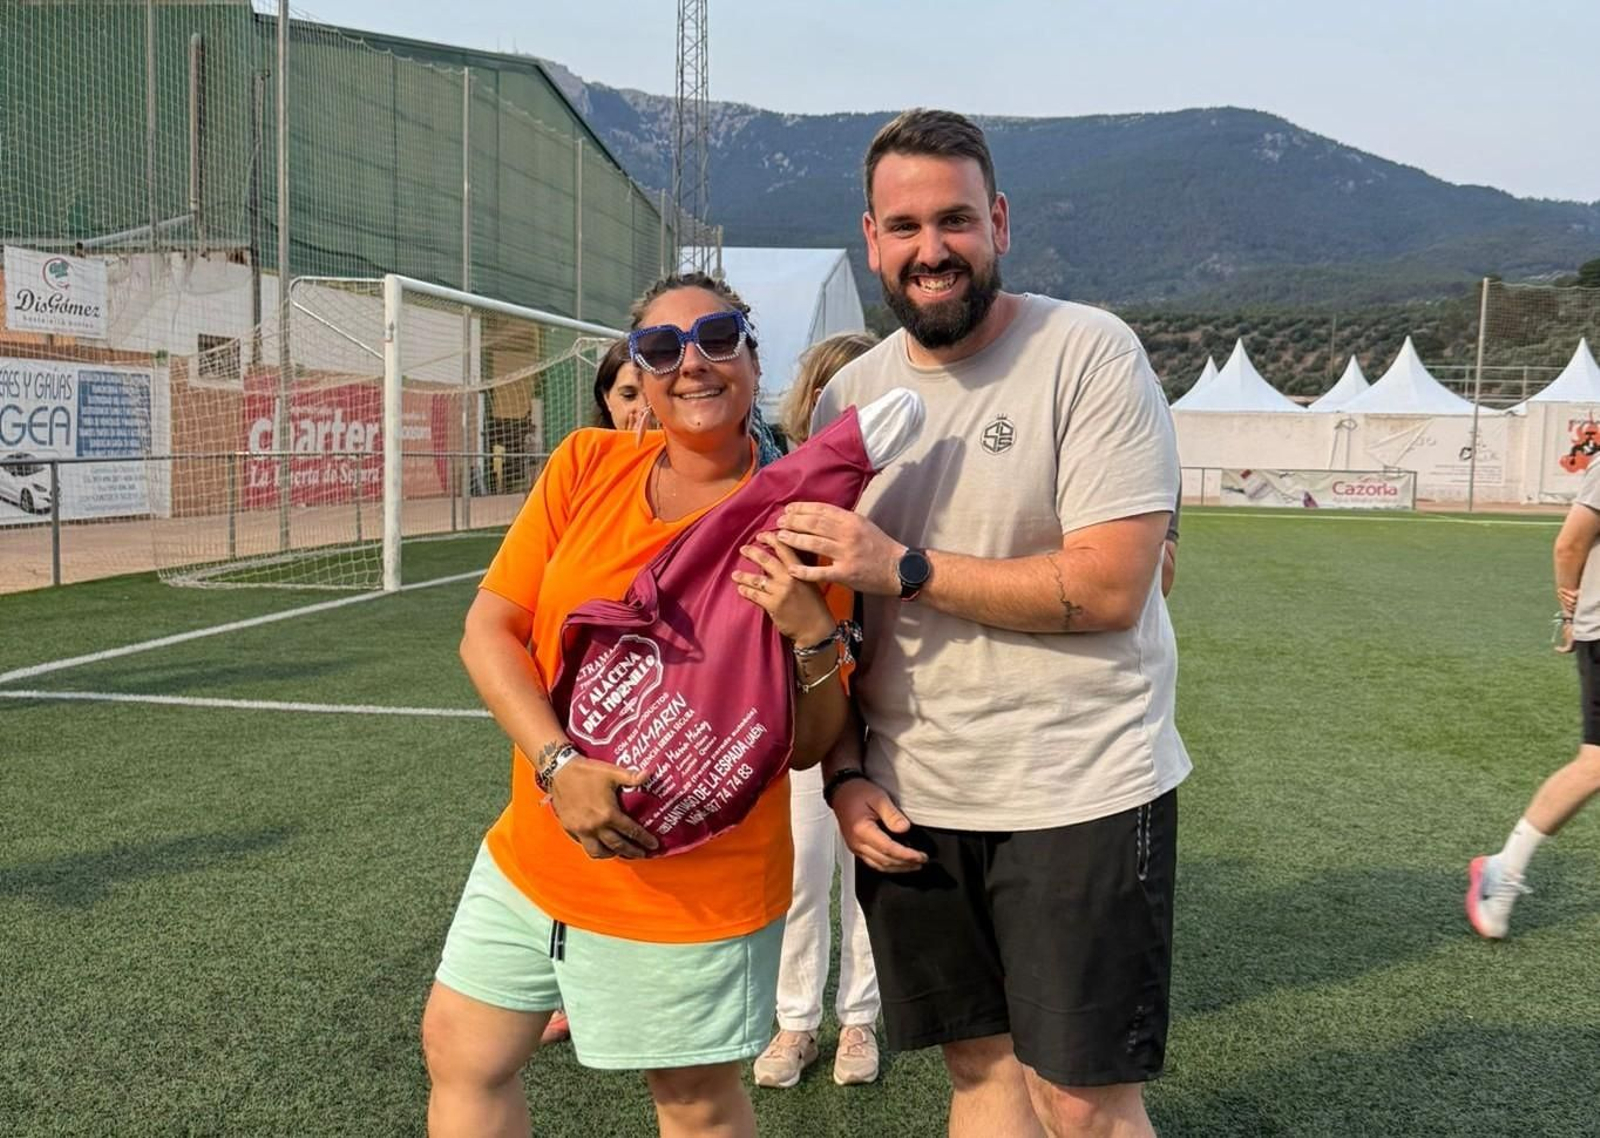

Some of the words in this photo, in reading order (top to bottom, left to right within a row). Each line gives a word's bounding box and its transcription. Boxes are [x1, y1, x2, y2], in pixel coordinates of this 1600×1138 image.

[14, 288, 100, 318] DisGómez
[0, 370, 20, 398] RES
[23, 371, 32, 399] Y
[250, 465, 269, 487] La
[324, 463, 338, 483] de
[582, 710, 607, 734] DEL
[614, 741, 628, 755] CON
[638, 692, 669, 729] ODUCTOS
[658, 730, 676, 749] SIERRA
[673, 708, 695, 732] SEGURA
[664, 795, 700, 826] SANTIAGO
[693, 782, 712, 801] DE
[704, 772, 722, 789] LA
[714, 739, 750, 778] ESPADA
[716, 787, 733, 804] 74
[726, 774, 743, 791] 74
[737, 763, 753, 780] 83
